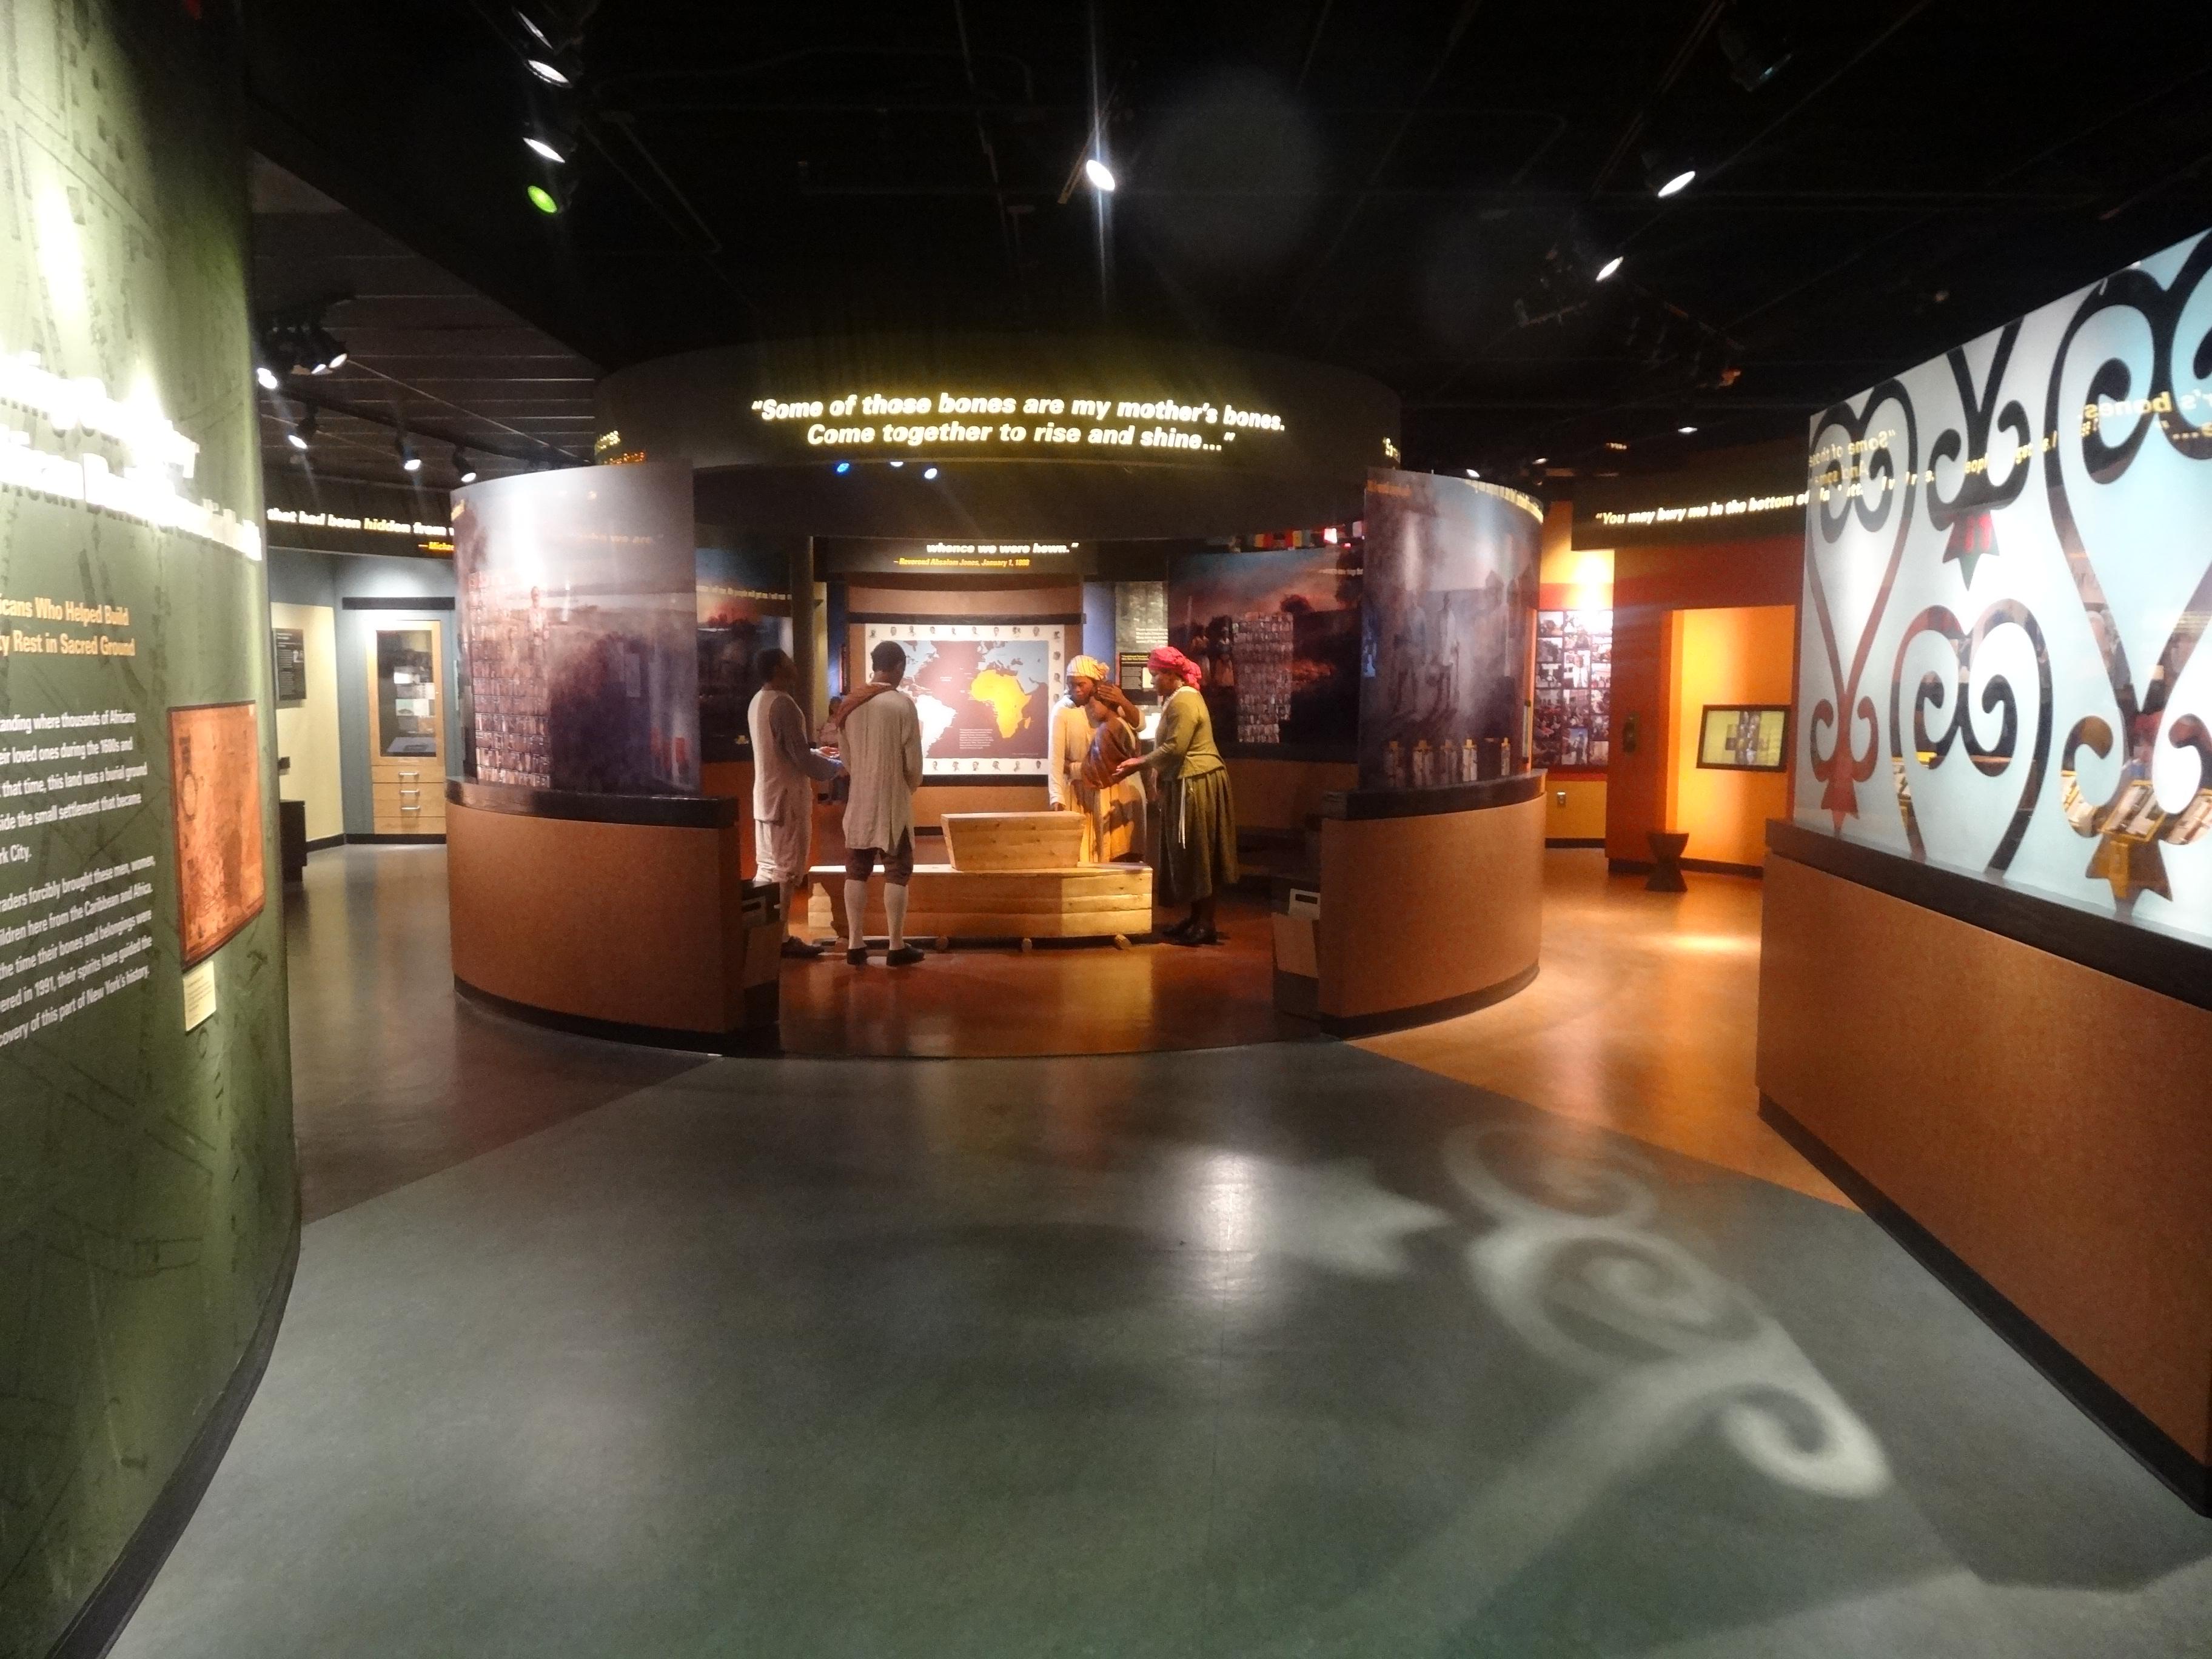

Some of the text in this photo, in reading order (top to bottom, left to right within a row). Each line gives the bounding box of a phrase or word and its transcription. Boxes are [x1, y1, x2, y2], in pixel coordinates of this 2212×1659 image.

[752, 392, 1285, 431] “Some of those bones are my mother's bones.
[808, 424, 875, 444] Come
[883, 421, 993, 446] together
[1000, 423, 1026, 441] to
[1034, 423, 1081, 443] rise
[1088, 425, 1135, 445] and
[299, 511, 325, 525] had
[328, 514, 361, 529] been
[364, 518, 411, 533] hidden
[413, 521, 446, 535] from
[1595, 512, 1625, 525] “You
[1627, 510, 1655, 525] may
[1657, 507, 1687, 522] bury
[1687, 504, 1709, 518] me
[1710, 502, 1723, 516] in
[1725, 500, 1746, 514] the
[1748, 494, 1794, 512] bottom
[927, 543, 974, 553] whence
[978, 545, 996, 553] we
[999, 544, 1030, 553] were
[981, 558, 1007, 568] January
[35, 597, 62, 620] Who
[65, 600, 103, 627] Helped
[105, 605, 130, 626] Build
[13, 629, 43, 652] Rest
[45, 632, 58, 653] in
[61, 633, 98, 655] Sacred
[100, 635, 136, 656] Ground
[33, 713, 60, 729] where
[61, 711, 100, 728] thousands
[101, 710, 109, 725] of
[110, 709, 136, 724] Africans
[12, 745, 38, 763] loved
[38, 747, 59, 760] ones
[61, 741, 86, 760] during
[87, 740, 99, 756] the
[120, 736, 133, 751] and
[2, 761, 148, 798] that time, this land was a burial ground
[16, 810, 33, 828] the
[34, 805, 58, 825] small
[58, 799, 101, 819] settlement
[101, 796, 116, 811] that
[116, 793, 142, 808] became
[10, 844, 32, 863] City.
[29, 880, 61, 903] forcibly
[62, 871, 93, 893] brought
[93, 868, 113, 884] these
[113, 863, 130, 877] men,
[130, 855, 156, 872] women,
[27, 919, 49, 937] here
[49, 912, 69, 930] from
[70, 904, 84, 922] the
[84, 894, 120, 917] Caribbean
[120, 886, 133, 903] and
[133, 881, 153, 899] Africa.
[15, 955, 36, 974] time
[37, 943, 58, 965] their
[59, 940, 84, 956] bones
[84, 926, 99, 947] and
[99, 916, 135, 940] belongings
[135, 910, 152, 925] were
[24, 985, 33, 1003] in
[35, 975, 57, 997] 1991,
[57, 967, 77, 988] their
[77, 958, 102, 982] spirits
[101, 953, 119, 969] have
[119, 937, 142, 964] guided
[141, 934, 152, 949] the
[30, 1012, 41, 1032] of
[41, 1006, 58, 1027] this
[59, 997, 77, 1022] part
[77, 990, 85, 1010] of
[86, 987, 105, 1005] New
[104, 973, 126, 995] York's
[126, 965, 150, 983] history.
